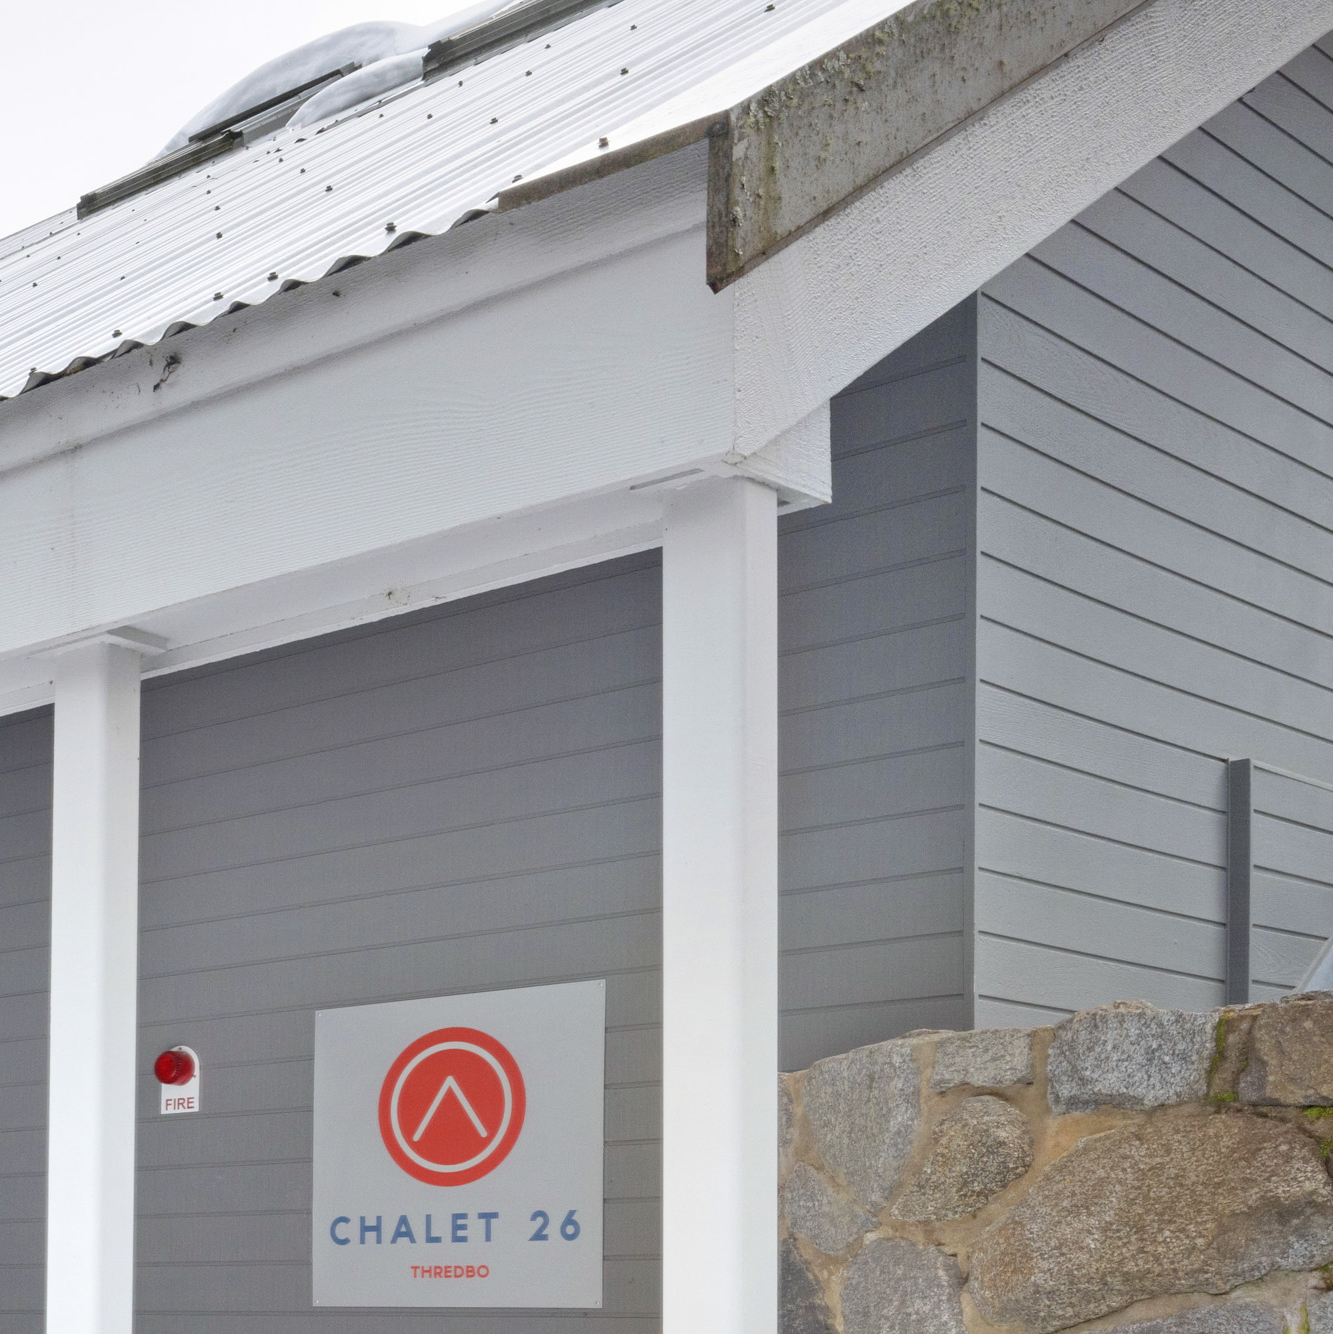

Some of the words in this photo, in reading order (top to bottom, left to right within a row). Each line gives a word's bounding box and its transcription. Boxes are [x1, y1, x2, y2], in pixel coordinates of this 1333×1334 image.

[165, 1097, 195, 1111] FIRE
[329, 1211, 500, 1246] CHALET
[528, 1209, 581, 1242] 26
[410, 1264, 490, 1279] THREDBO
